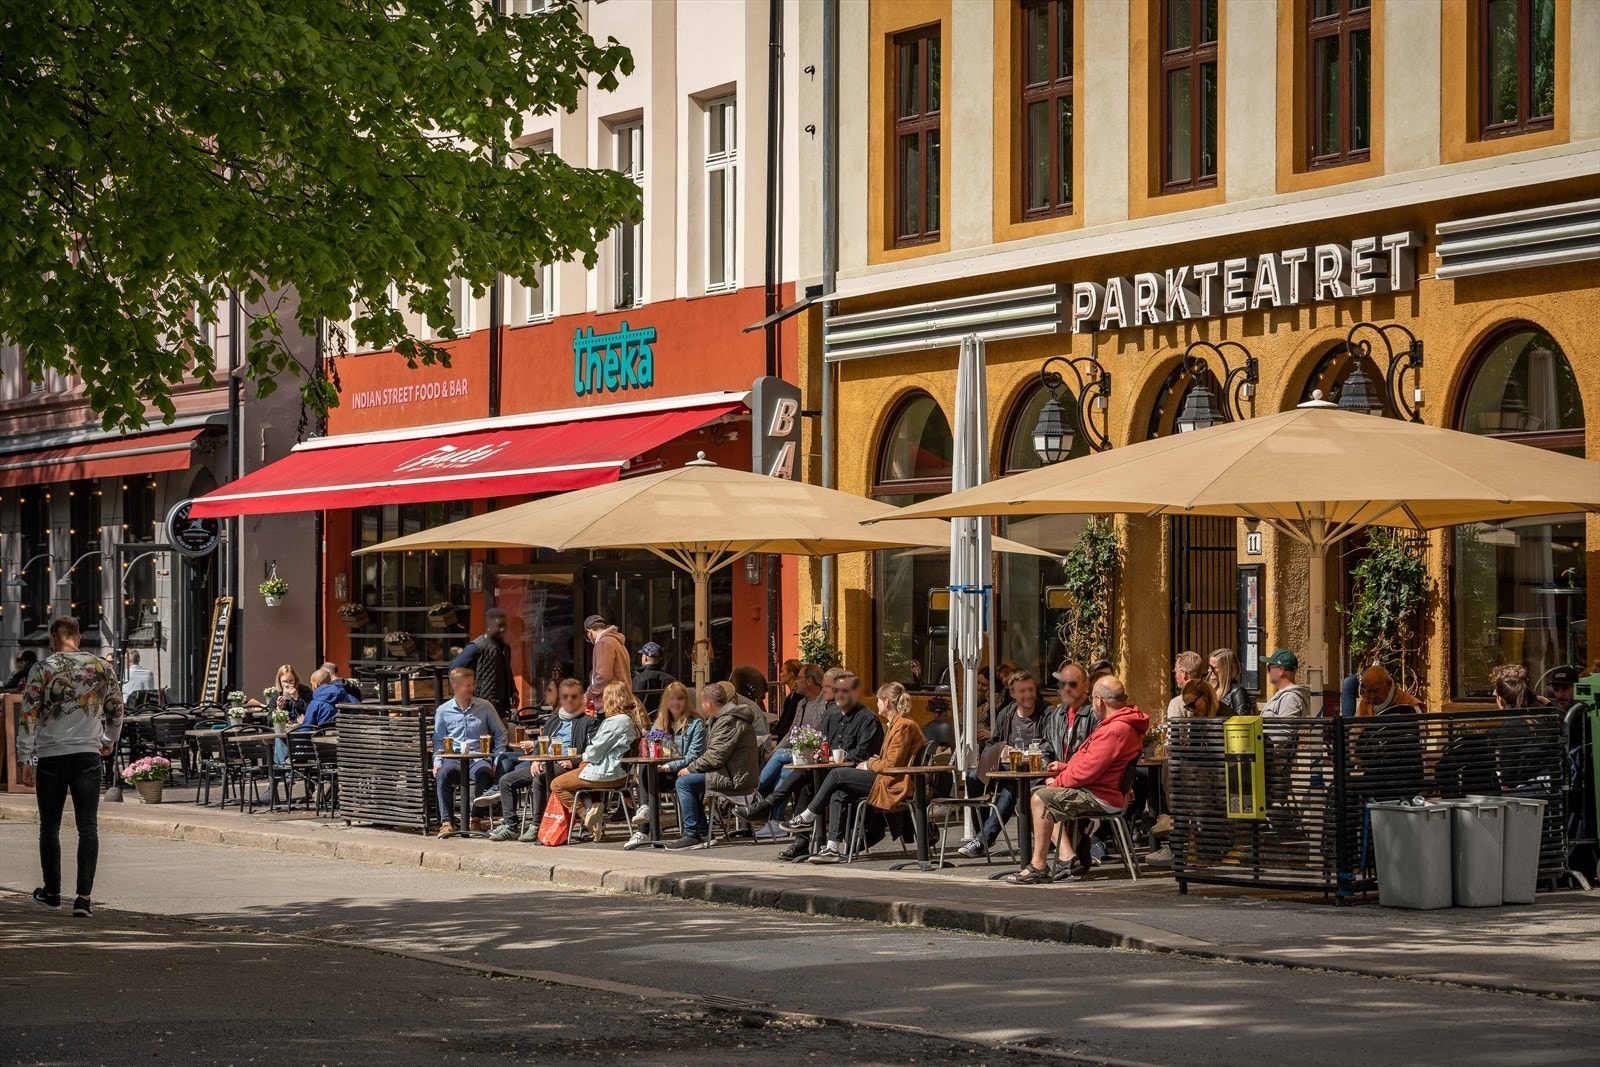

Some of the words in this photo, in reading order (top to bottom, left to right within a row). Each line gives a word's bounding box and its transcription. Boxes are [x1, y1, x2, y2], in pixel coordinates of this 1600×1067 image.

[1072, 231, 1412, 333] PARKTEATRET
[573, 320, 657, 397] theka
[352, 389, 382, 410] INDIAN
[383, 385, 414, 405] STREET
[415, 382, 441, 401] FOOD
[441, 380, 448, 398] &
[449, 378, 469, 397] BAR
[1248, 535, 1258, 552] 11
